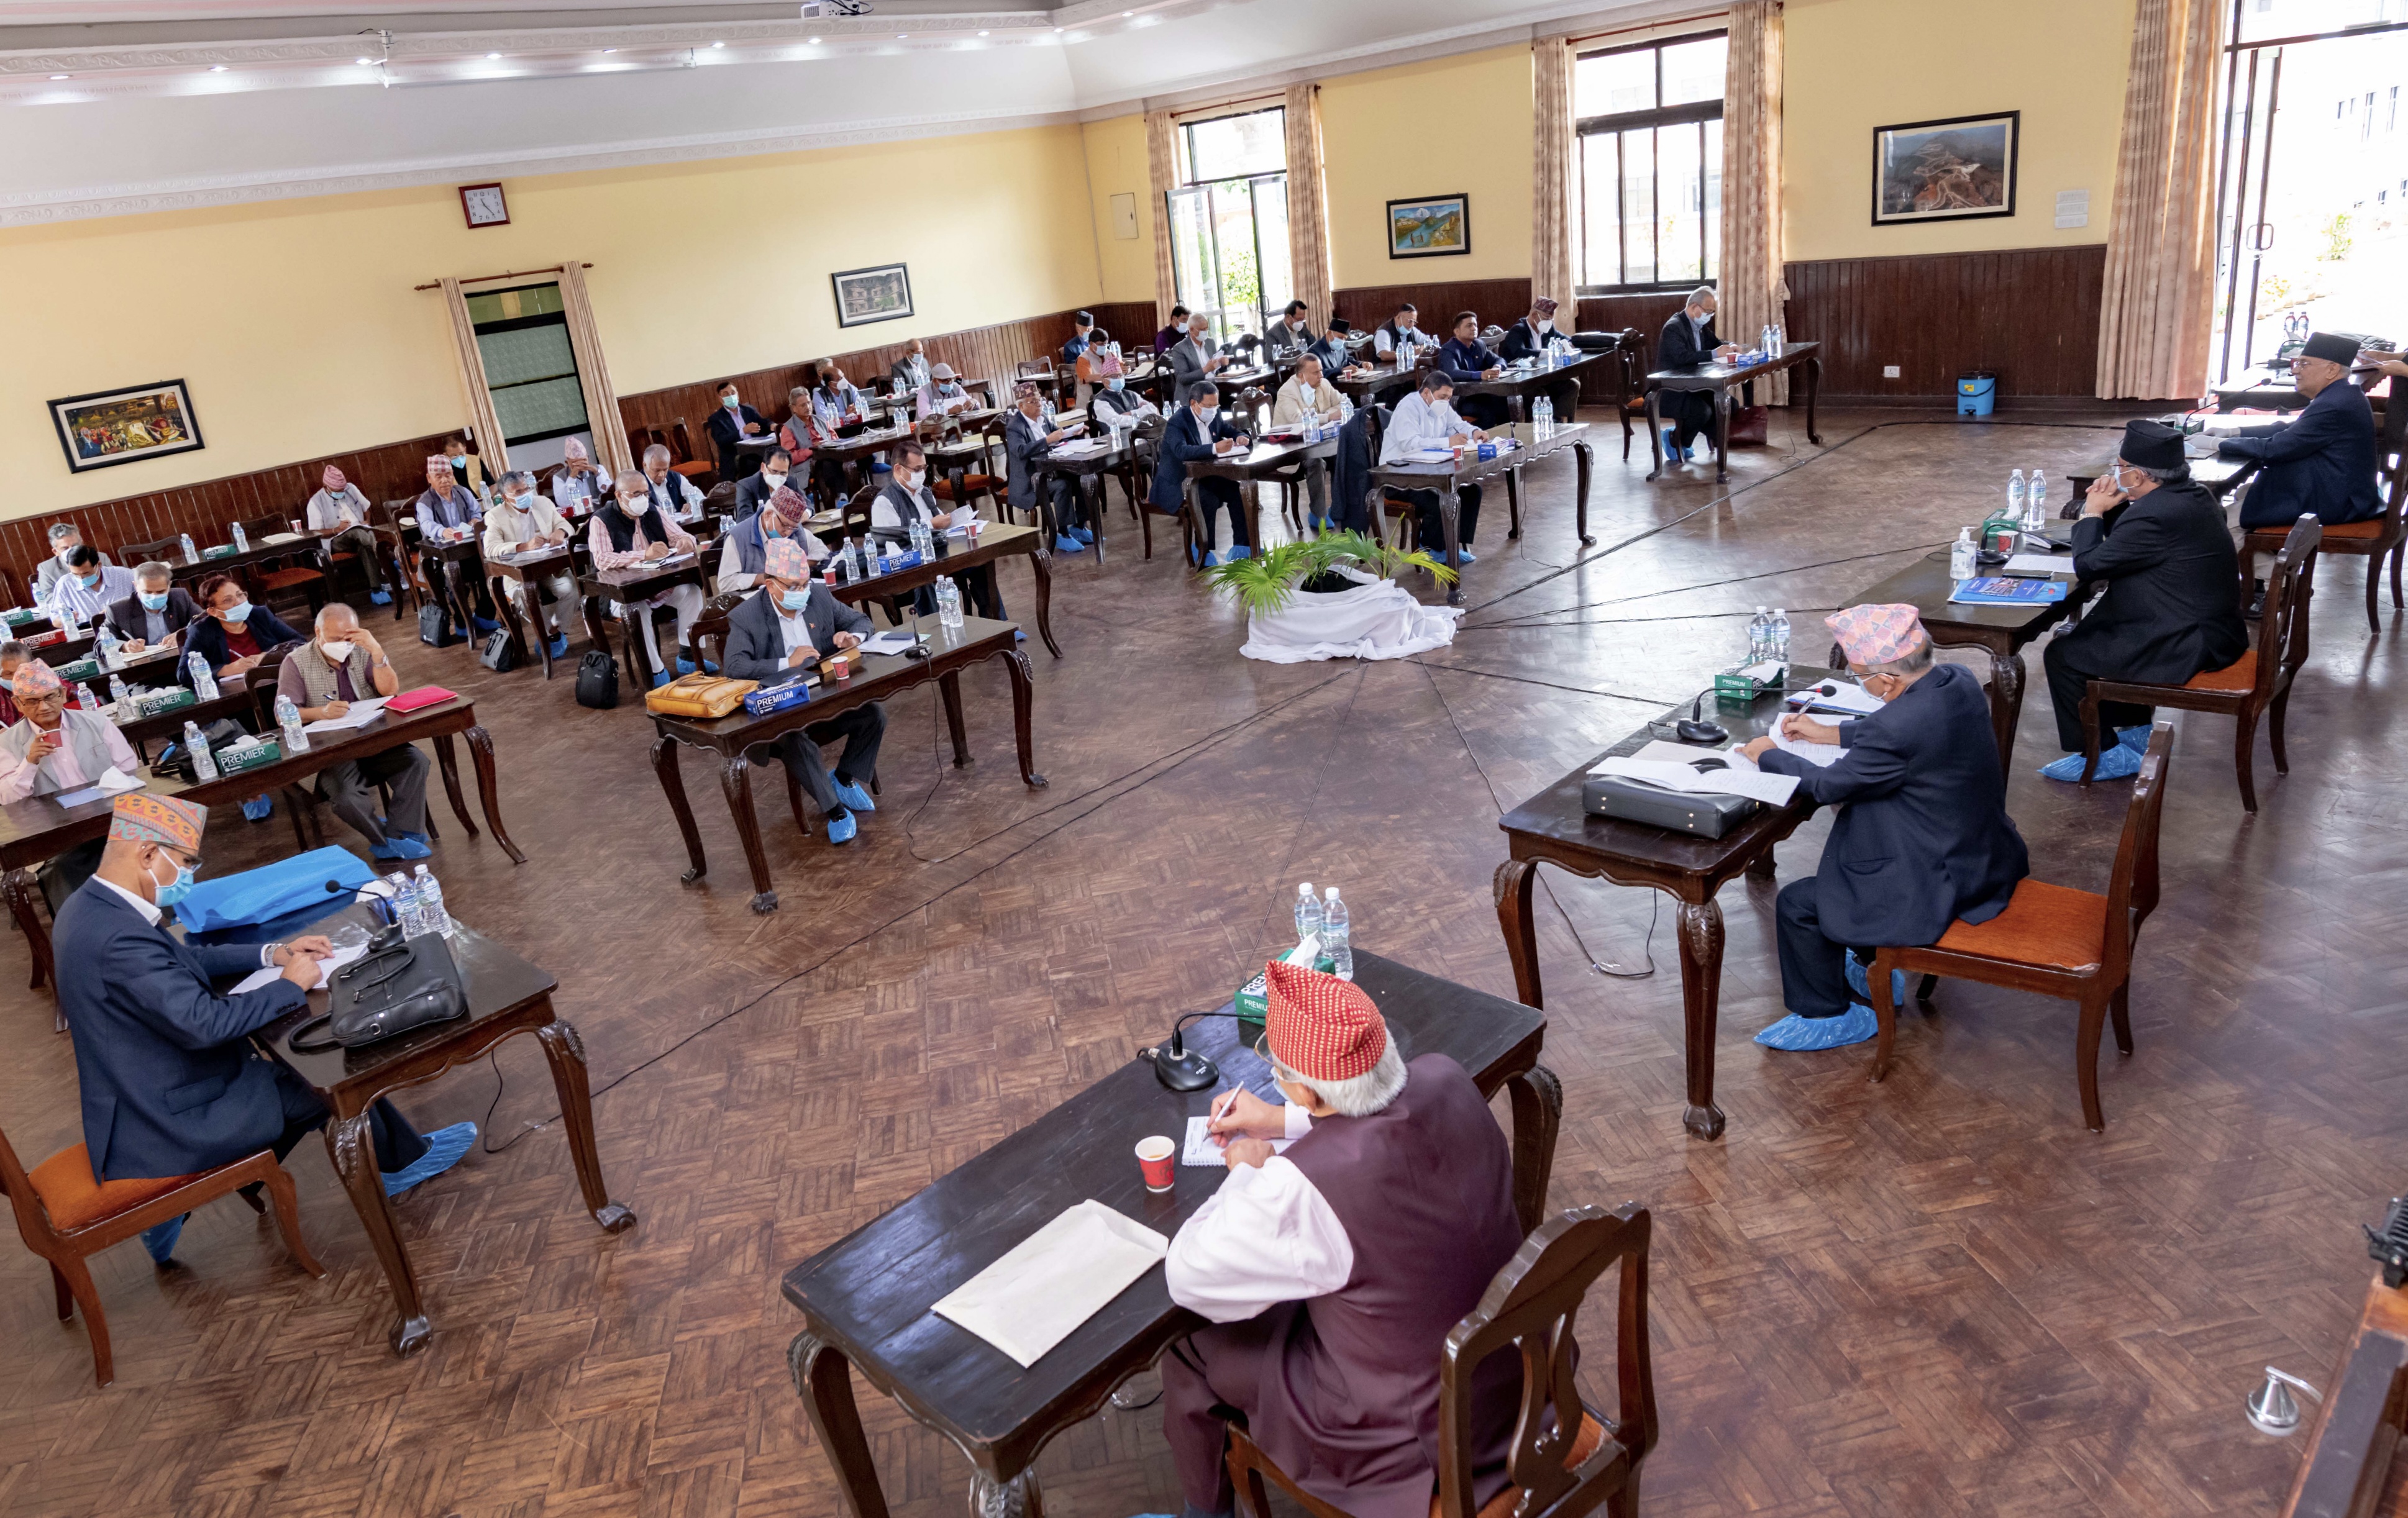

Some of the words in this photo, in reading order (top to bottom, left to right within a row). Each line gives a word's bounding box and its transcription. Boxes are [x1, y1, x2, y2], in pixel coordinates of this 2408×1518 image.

[889, 553, 913, 567] PREMIER
[3, 612, 24, 622] EMIER
[25, 634, 56, 646] PREMIER
[56, 665, 87, 678] REMIER
[1722, 679, 1746, 687] PREMIUM
[142, 694, 181, 711] PREMIER
[756, 691, 794, 708] PREMIUM
[221, 747, 265, 766] PREMIER
[1244, 999, 1268, 1012] PREMIU
